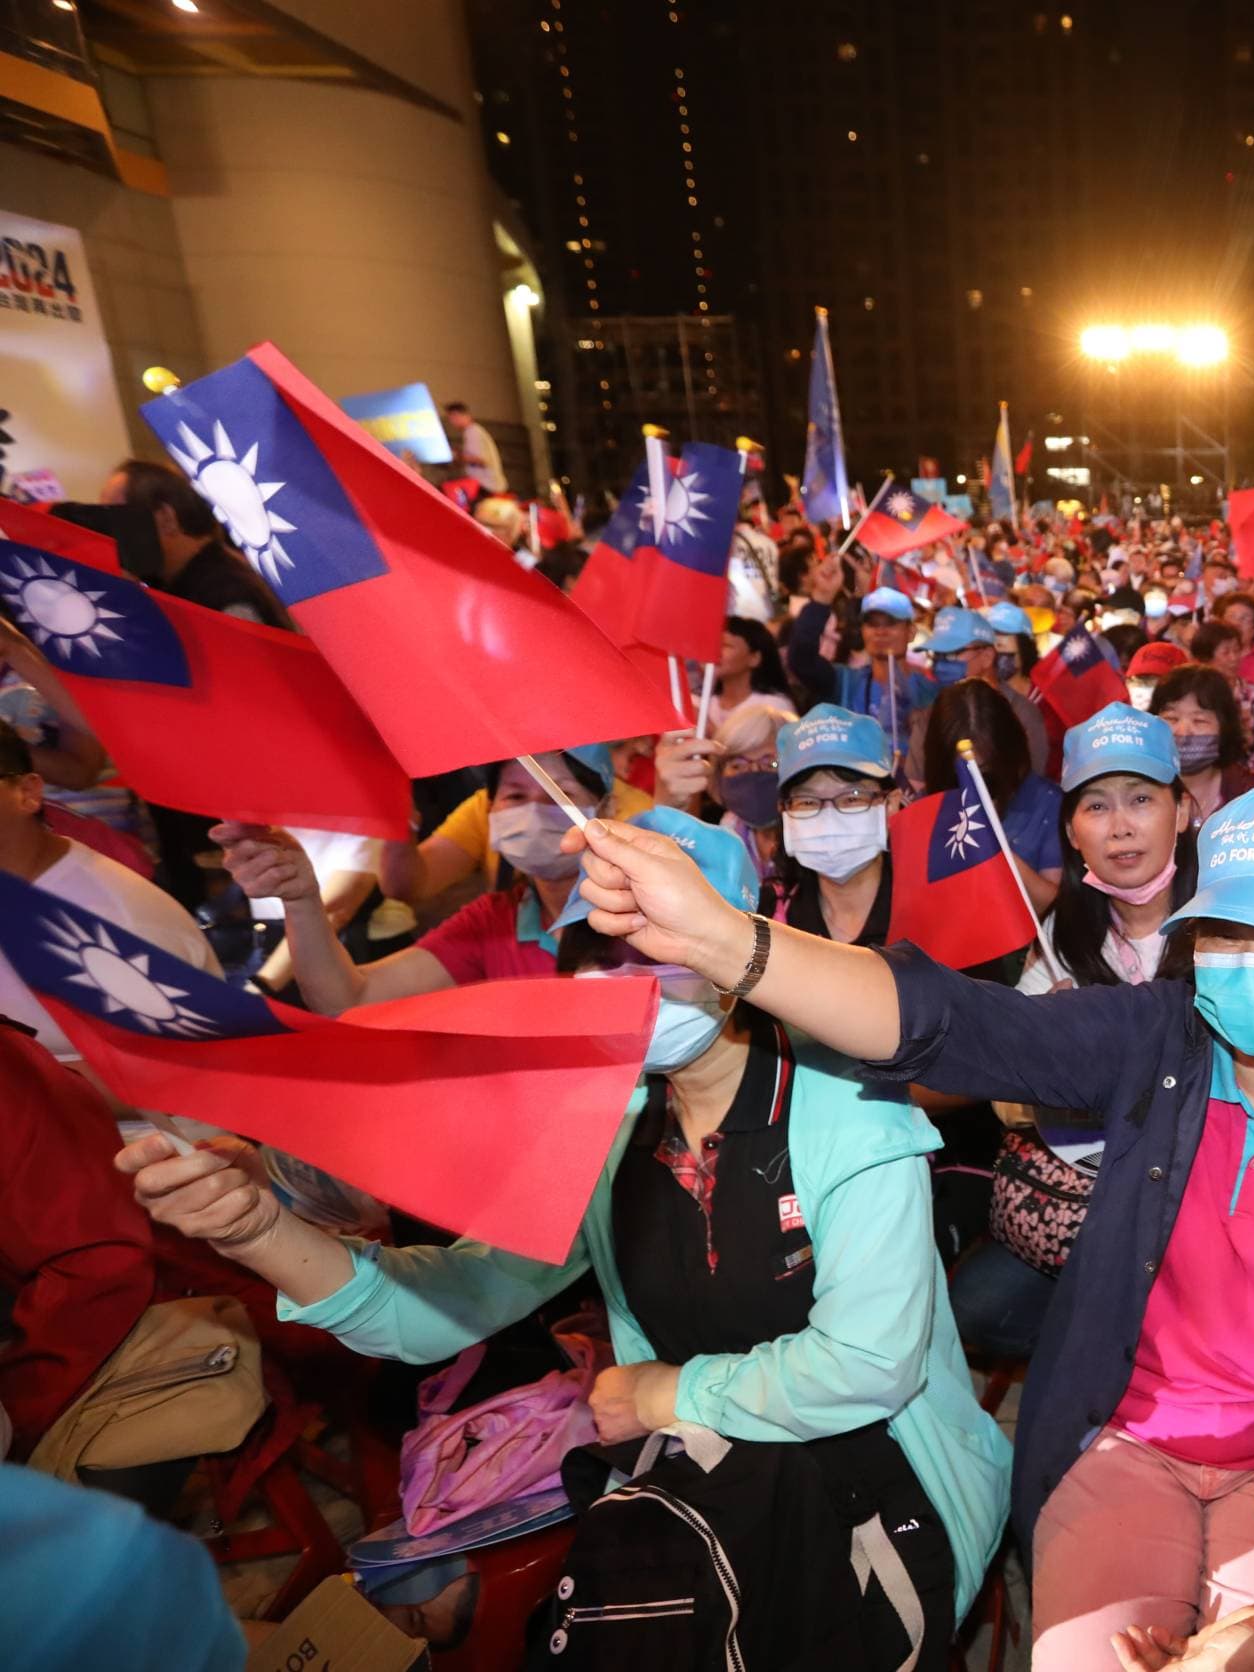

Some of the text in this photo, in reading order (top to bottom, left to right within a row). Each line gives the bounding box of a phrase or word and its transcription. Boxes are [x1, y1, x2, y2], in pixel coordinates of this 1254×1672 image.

[798, 737, 815, 751] GO
[815, 732, 838, 744] FOR
[1092, 736, 1109, 749] GO
[1111, 734, 1133, 745] FOR
[1210, 851, 1227, 868] GO
[274, 1637, 318, 1672] BO
